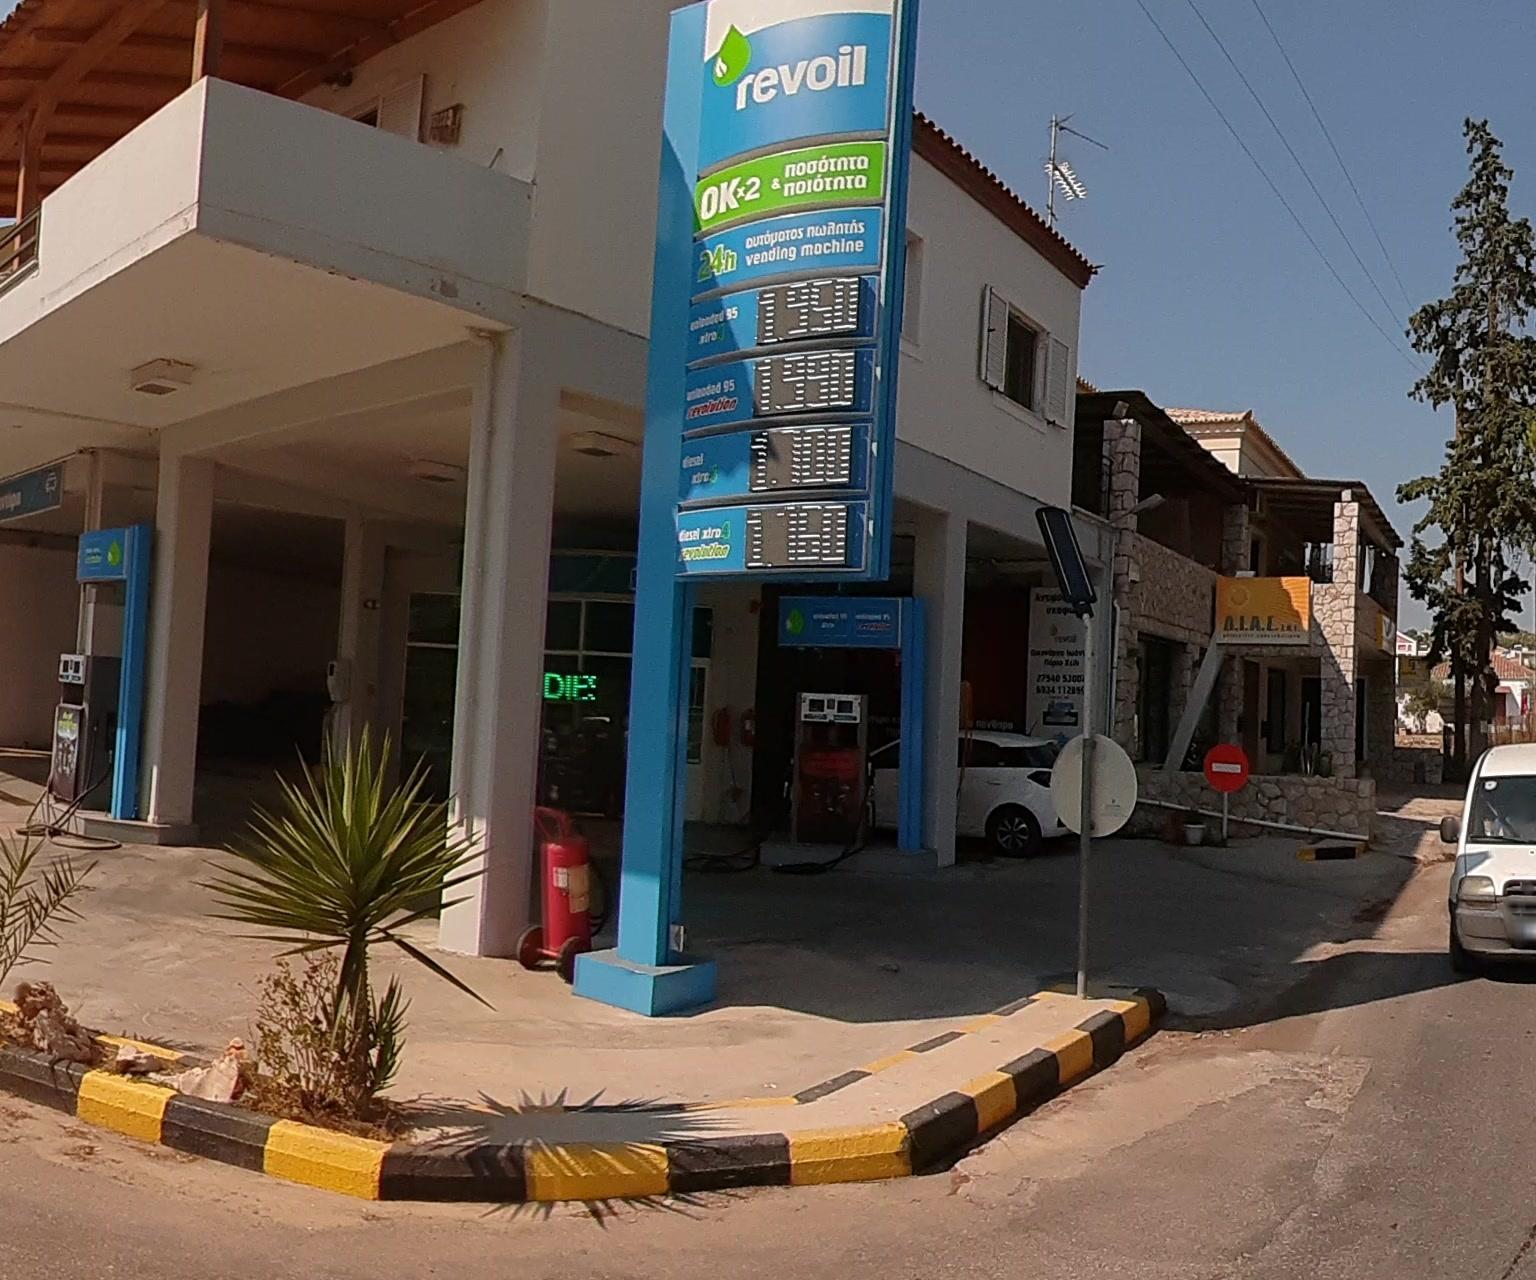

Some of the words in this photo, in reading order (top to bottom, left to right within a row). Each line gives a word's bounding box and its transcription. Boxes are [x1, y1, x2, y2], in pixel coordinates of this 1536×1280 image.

[735, 45, 867, 111] revoil
[784, 155, 869, 178] ποσότητα
[783, 175, 867, 197] ποιότητα
[745, 226, 804, 249] αυτόματος
[807, 220, 865, 238] πωλητής
[699, 243, 738, 282] 24h
[745, 243, 797, 266] vending
[801, 238, 865, 258] machine
[725, 306, 738, 320] 95
[723, 379, 735, 393] 95
[688, 396, 738, 419] revolution
